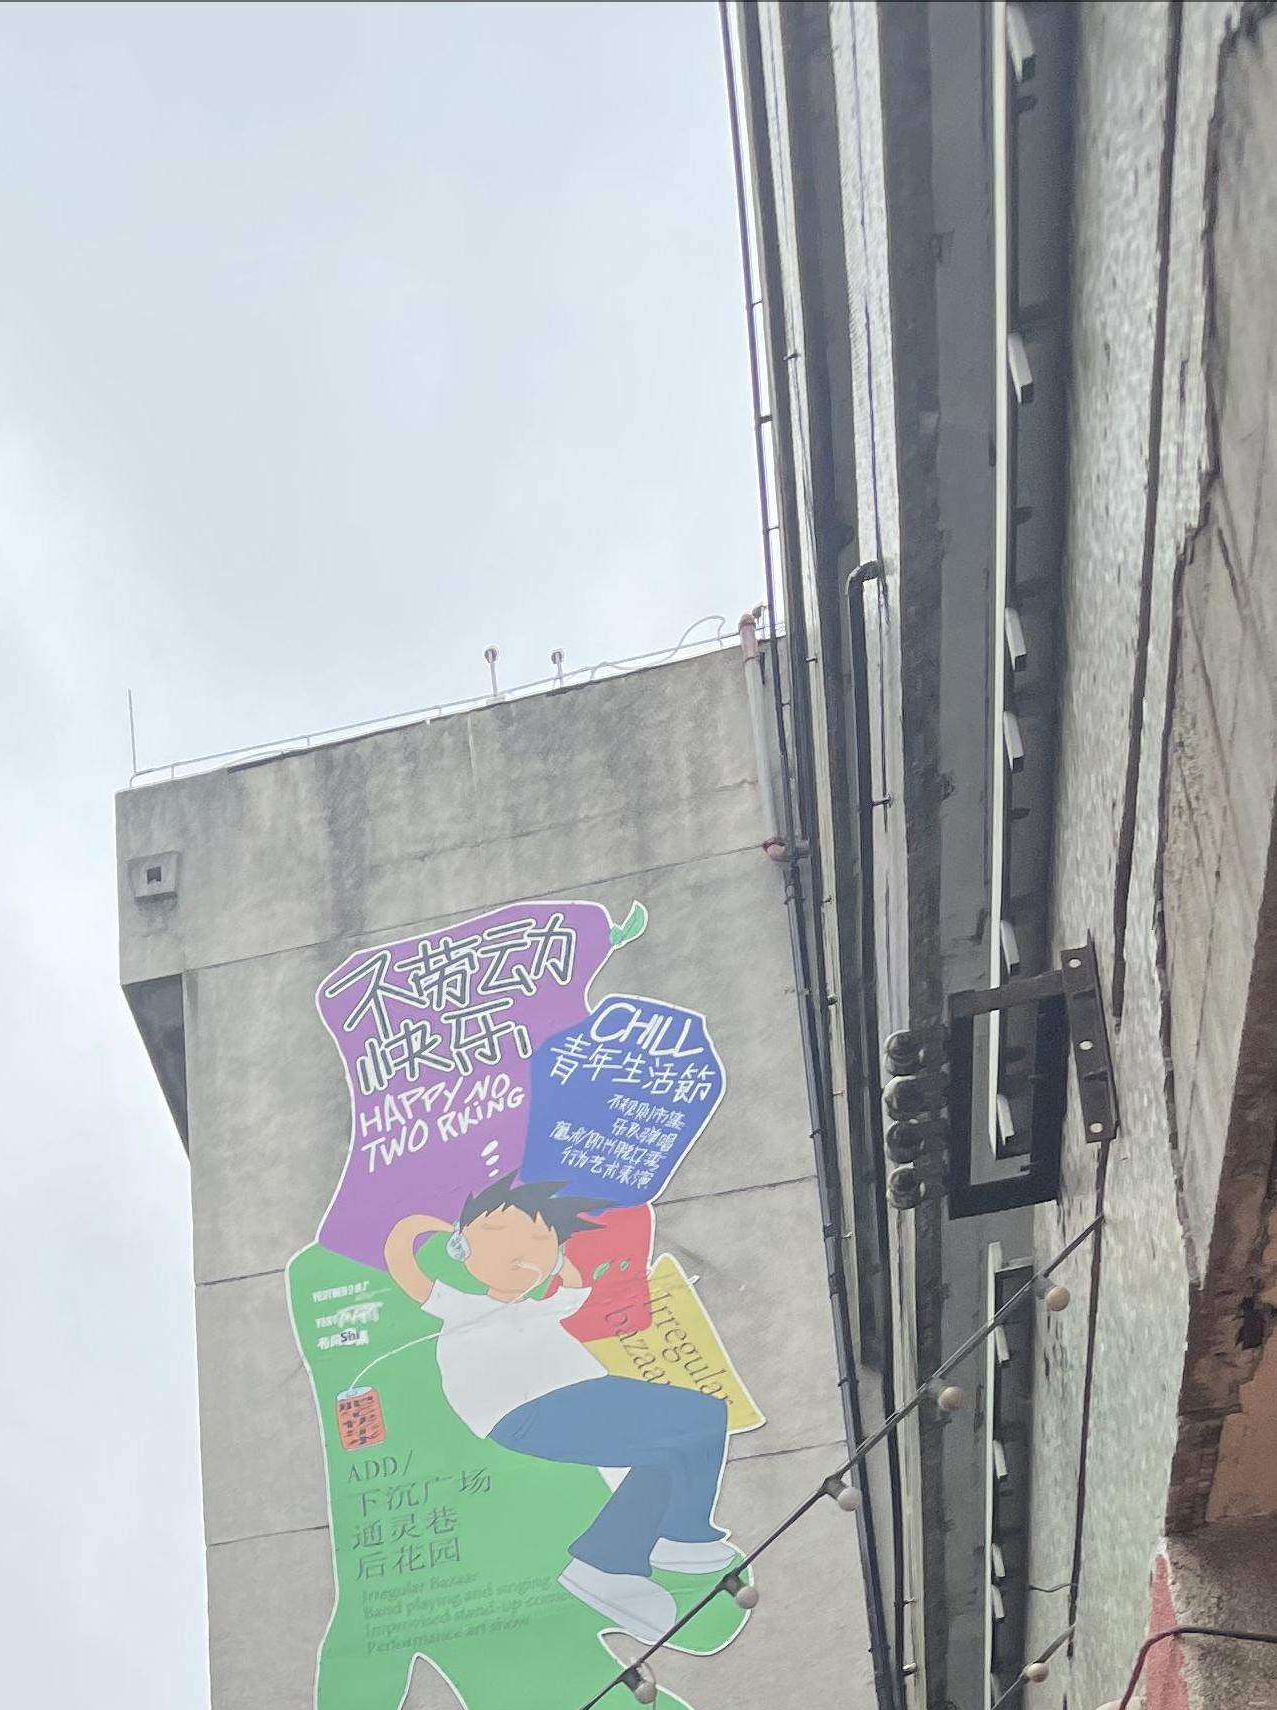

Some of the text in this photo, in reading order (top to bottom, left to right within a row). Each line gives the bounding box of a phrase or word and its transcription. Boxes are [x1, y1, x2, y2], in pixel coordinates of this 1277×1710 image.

[325, 913, 577, 1045] 不劳动
[355, 997, 534, 1096] 快乐
[590, 1002, 704, 1058] CHILL
[359, 1073, 511, 1138] HAPPY NO
[361, 1119, 429, 1174] TWO
[354, 1466, 492, 1518] 下沉广场
[352, 1504, 458, 1550] 通灵巷
[354, 1537, 461, 1582] 后花园
